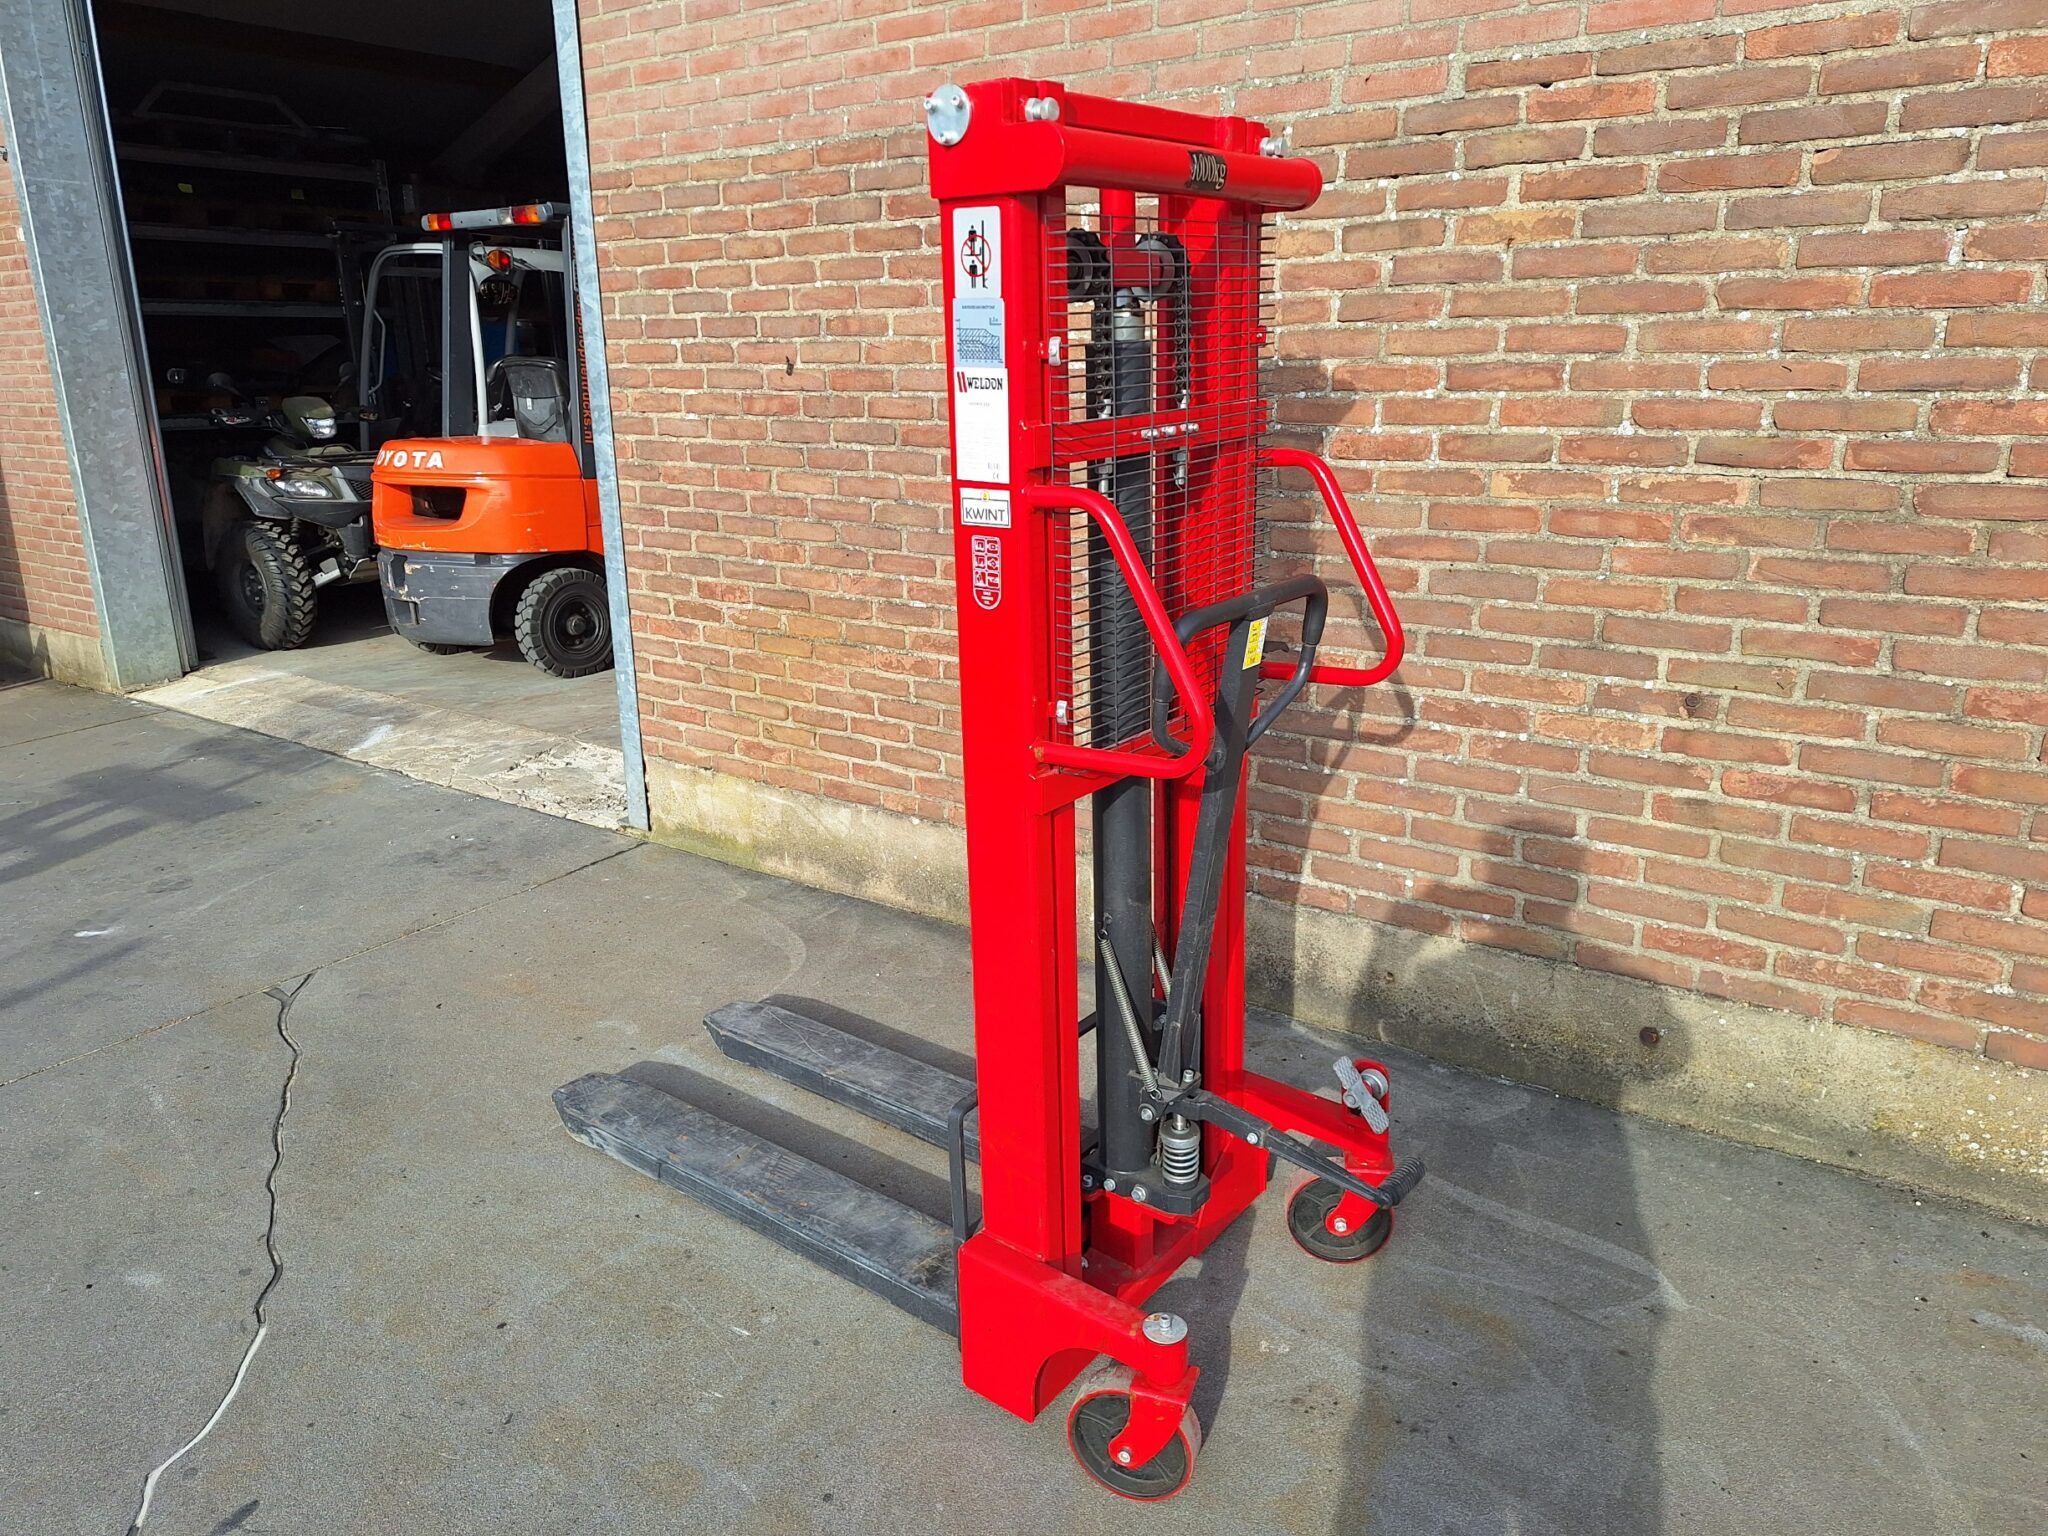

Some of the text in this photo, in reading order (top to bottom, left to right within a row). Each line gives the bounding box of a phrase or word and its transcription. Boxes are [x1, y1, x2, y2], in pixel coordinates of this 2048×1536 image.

[967, 376, 1003, 390] WELDON
[377, 450, 444, 469] OYOTA
[965, 507, 1005, 521] KWINT
